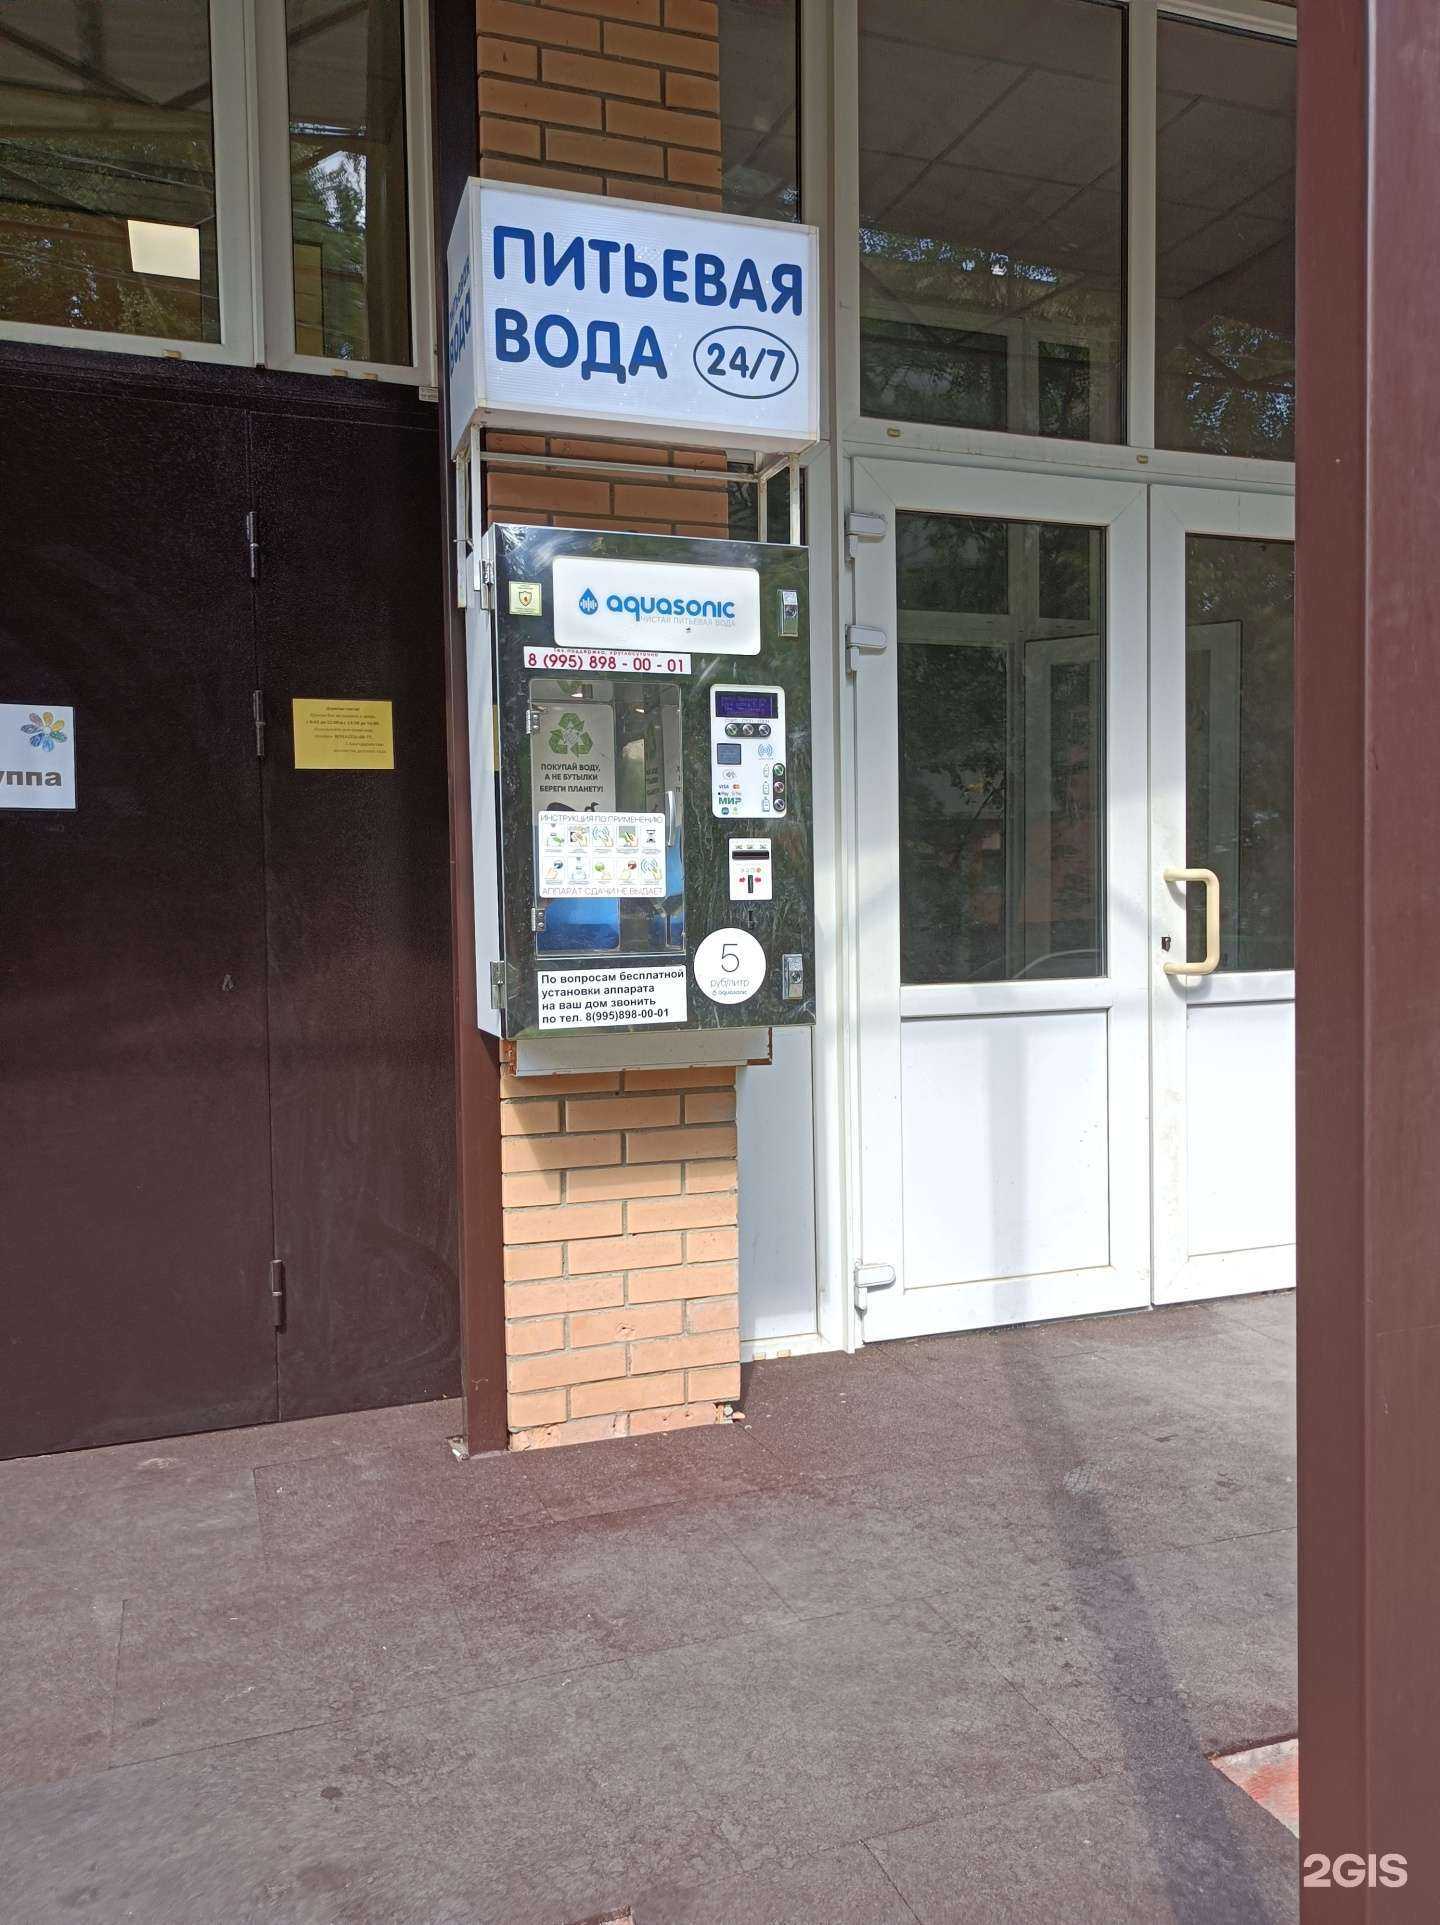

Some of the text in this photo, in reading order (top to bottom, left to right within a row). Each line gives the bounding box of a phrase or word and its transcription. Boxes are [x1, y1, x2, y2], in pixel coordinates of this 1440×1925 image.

[493, 225, 802, 316] ПИТЬЕВАЯ
[495, 307, 667, 384] ВОДА
[707, 343, 785, 382] 24/7
[606, 595, 735, 622] aquasonic
[528, 653, 537, 667] 8
[543, 654, 583, 670] (995)
[589, 655, 616, 669] 898
[633, 658, 651, 671] 00
[667, 659, 683, 672] 01
[541, 762, 577, 771] ПОКУПАЙ
[719, 797, 742, 805] МИР
[721, 943, 740, 973] 5
[541, 969, 684, 985] По вопросам бесплатной
[541, 984, 655, 999] установки аппарата
[542, 998, 656, 1010] на ваш дом звонить
[542, 1008, 669, 1024] по тел. 8(995)898-00-01
